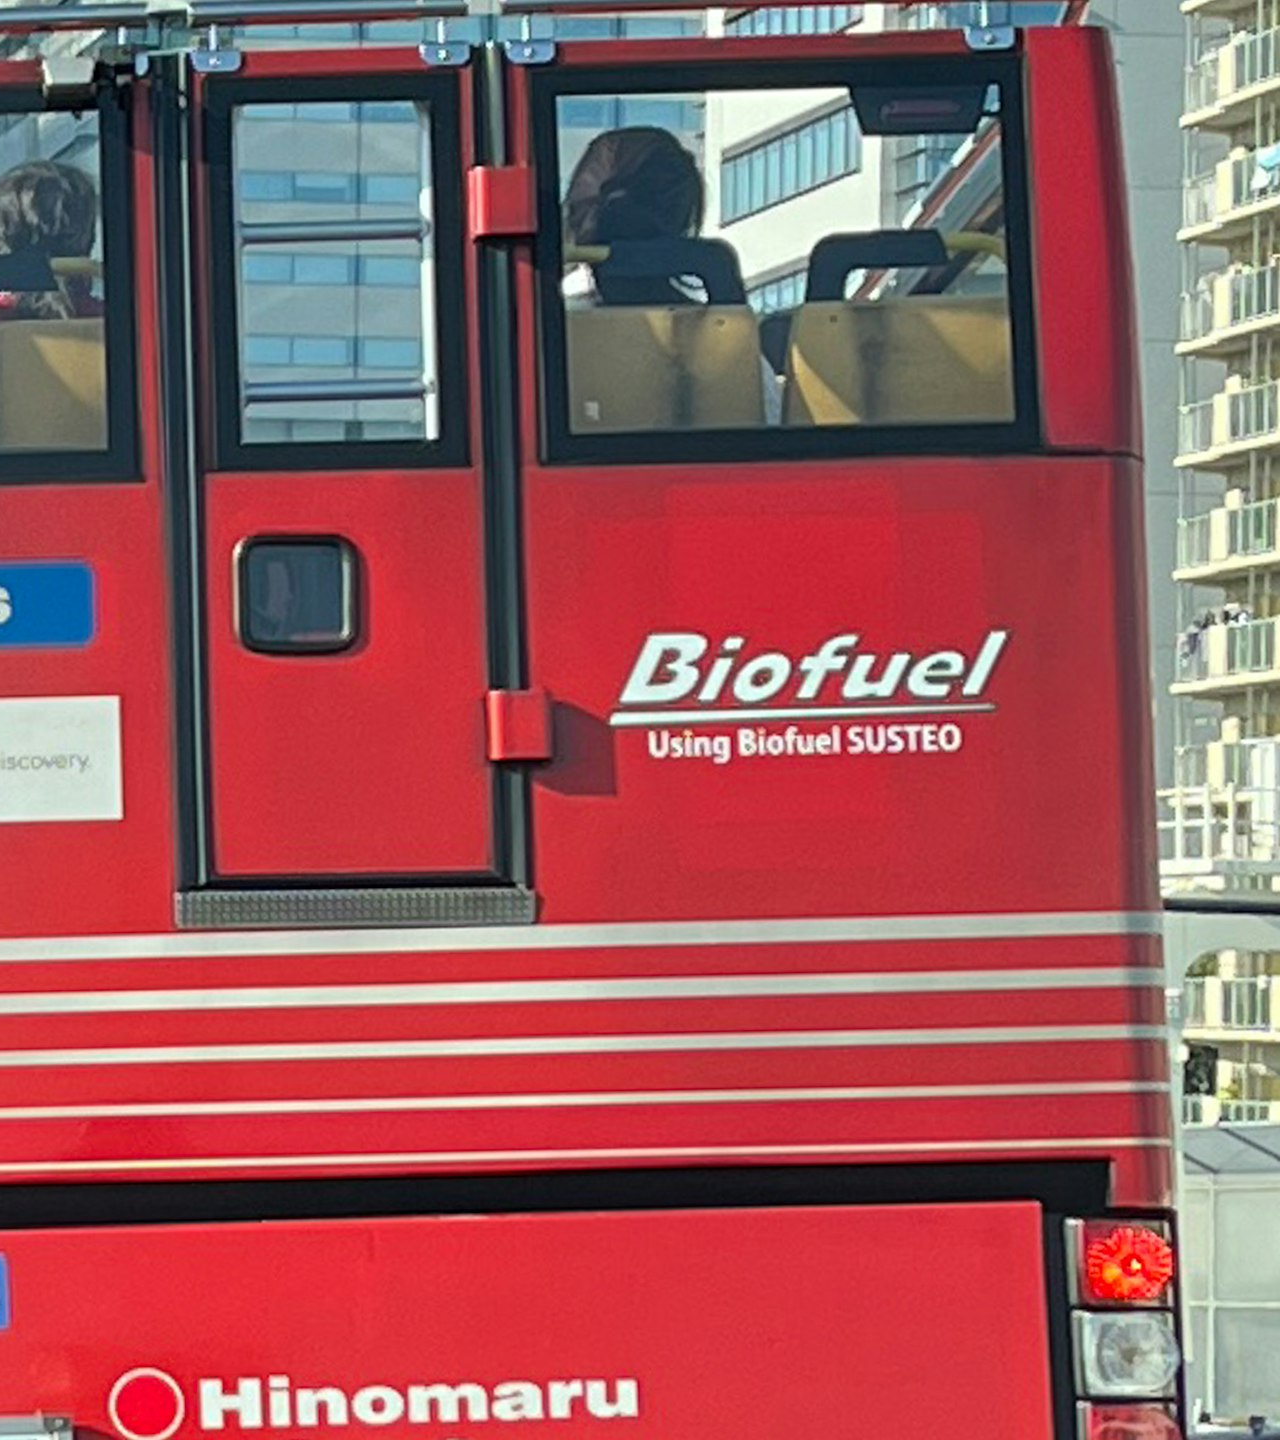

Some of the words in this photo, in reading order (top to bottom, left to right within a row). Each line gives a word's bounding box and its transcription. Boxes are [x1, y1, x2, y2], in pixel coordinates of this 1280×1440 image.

[618, 629, 1010, 704] Biofuel
[647, 729, 731, 765] Using
[737, 724, 842, 758] Biofuel
[847, 722, 963, 755] SUSTEO
[198, 1374, 640, 1431] Hinomaru
